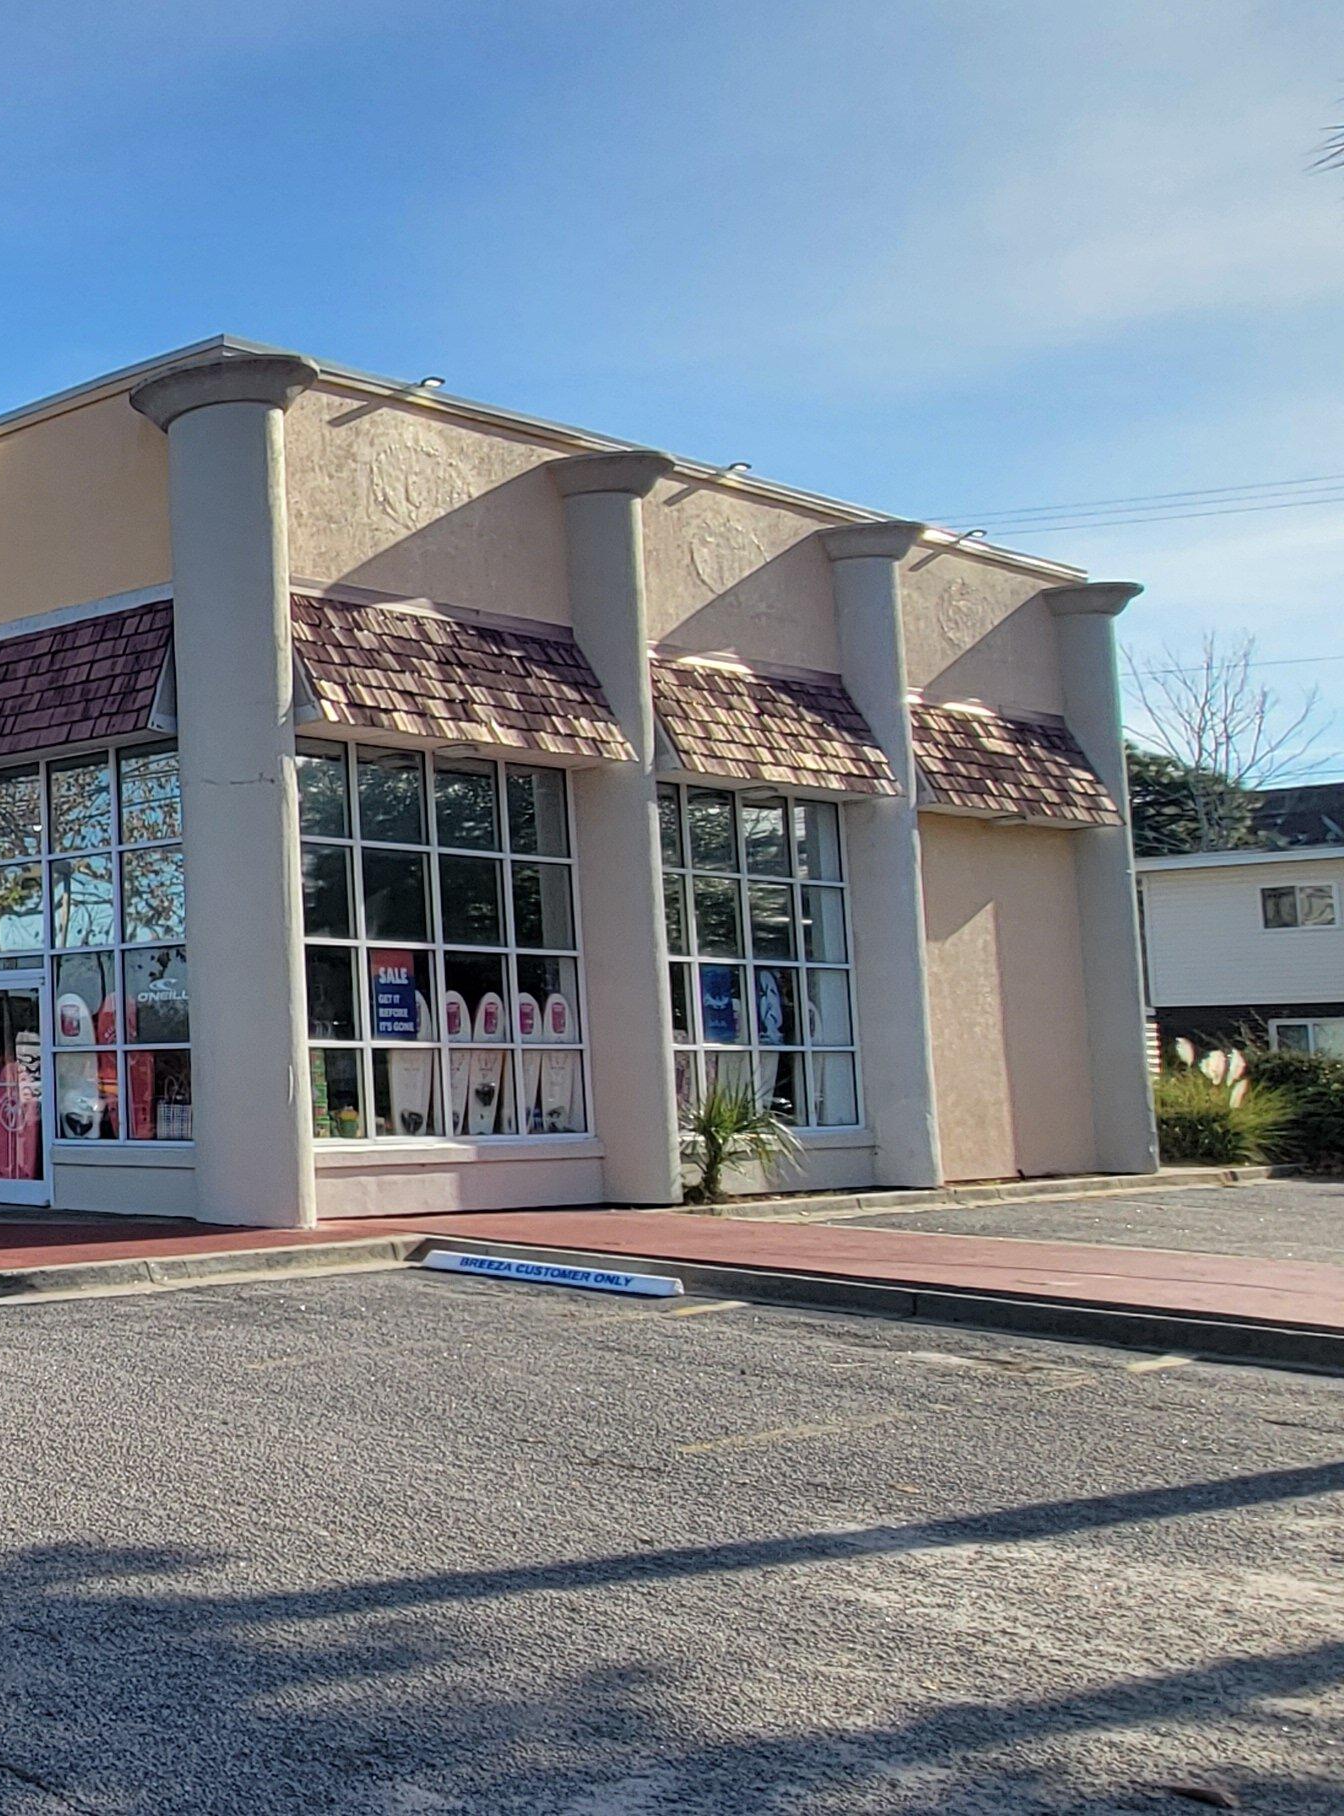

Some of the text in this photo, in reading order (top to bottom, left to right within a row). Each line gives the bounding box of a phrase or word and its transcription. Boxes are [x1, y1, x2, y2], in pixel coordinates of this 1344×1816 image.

[379, 967, 408, 984] SALE
[378, 994, 400, 1004] GET IT
[379, 1008, 408, 1017] BEFORE
[460, 1257, 634, 1287] BREEZA CUSTOMER ONLY
